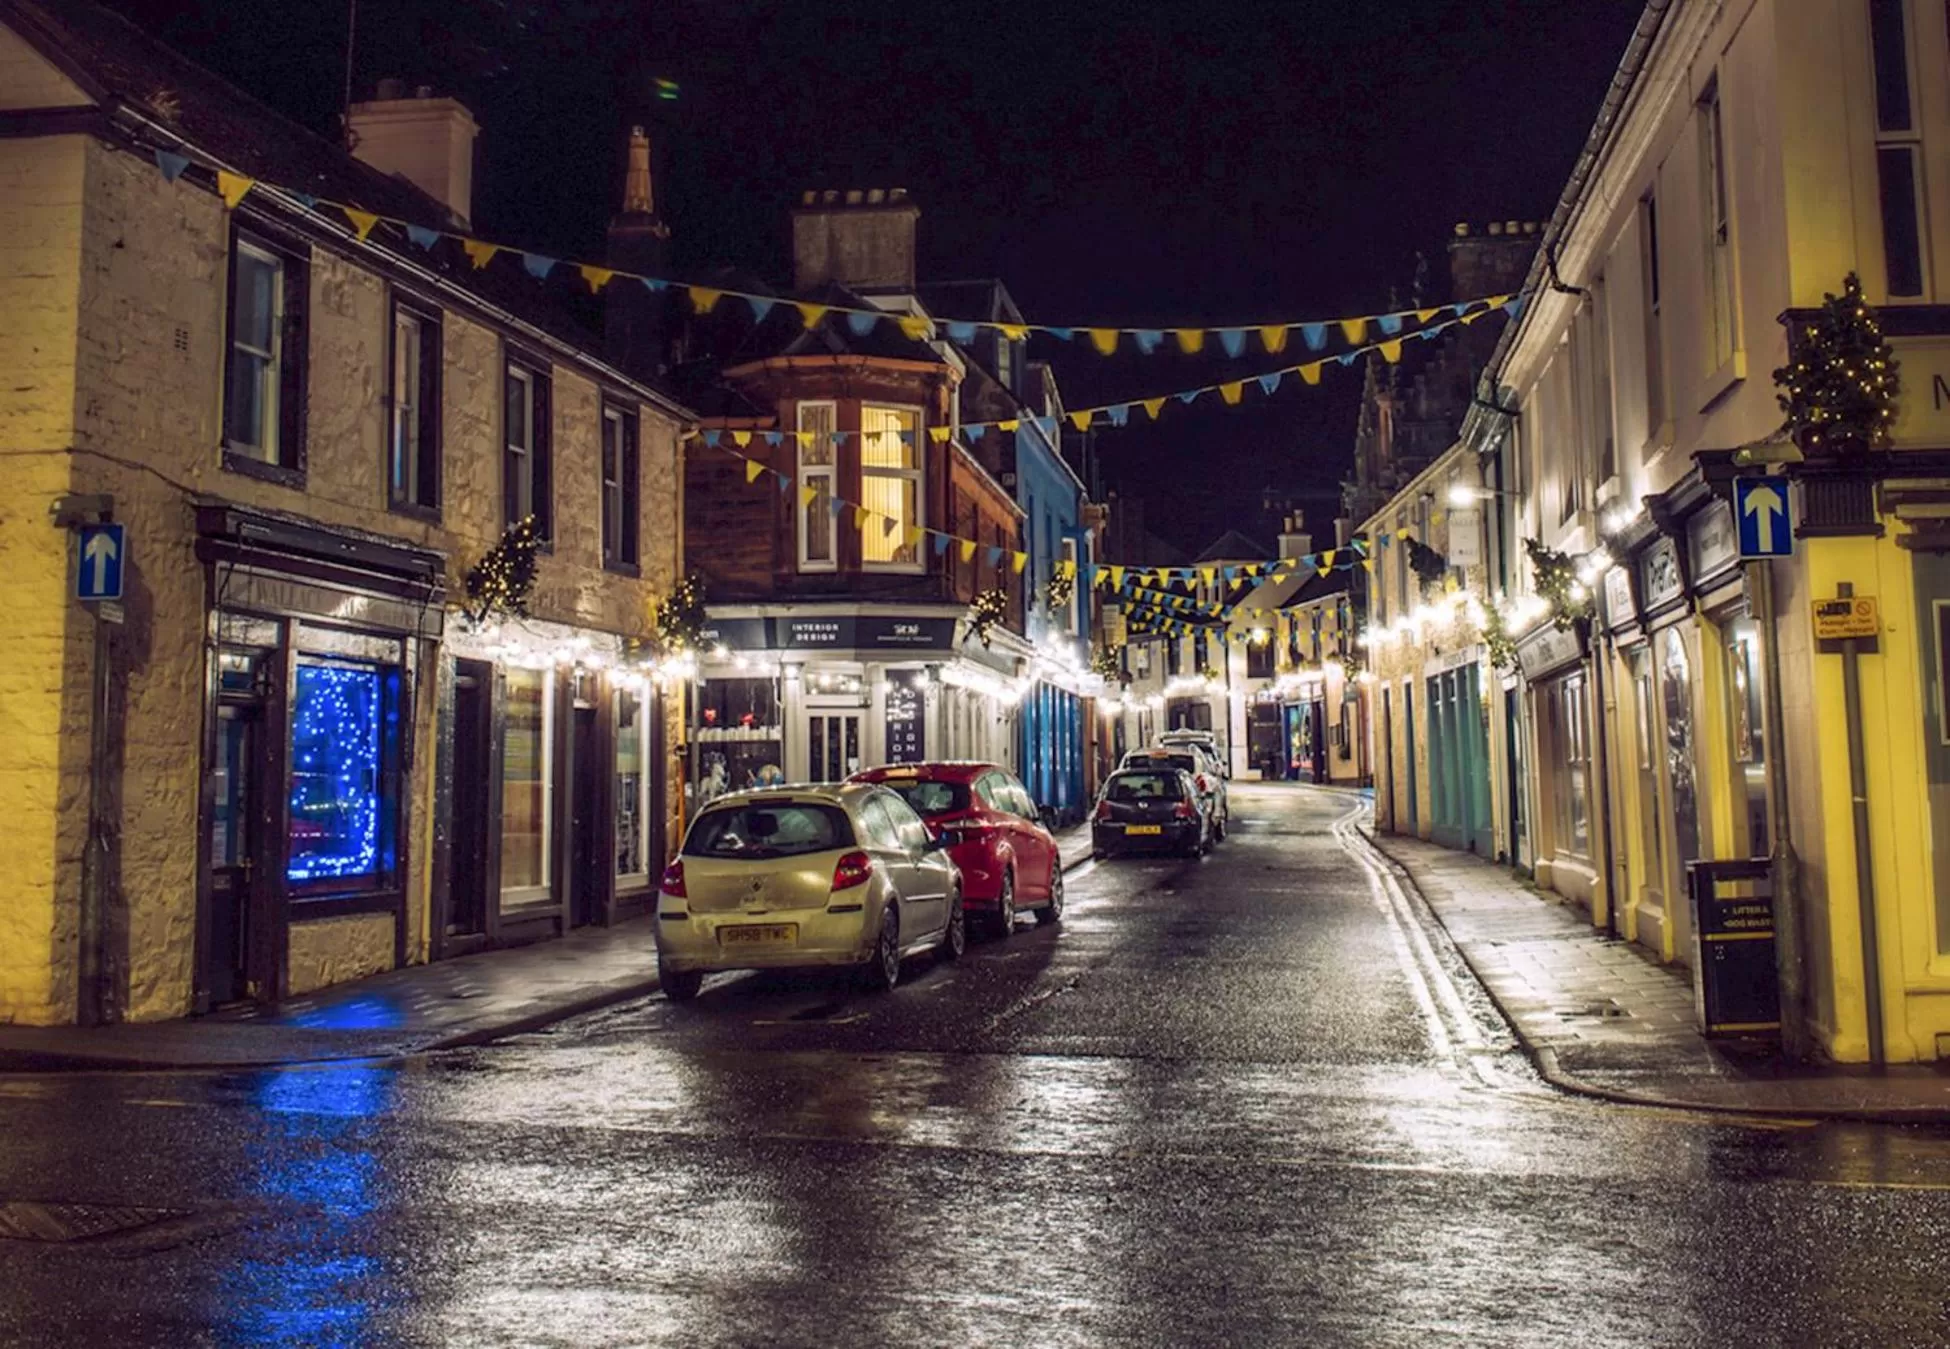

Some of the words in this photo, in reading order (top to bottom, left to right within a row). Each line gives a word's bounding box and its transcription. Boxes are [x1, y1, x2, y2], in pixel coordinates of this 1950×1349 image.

[792, 623, 839, 632] INTERIOR
[796, 633, 837, 642] DESIGN
[1746, 918, 1773, 927] WAST
